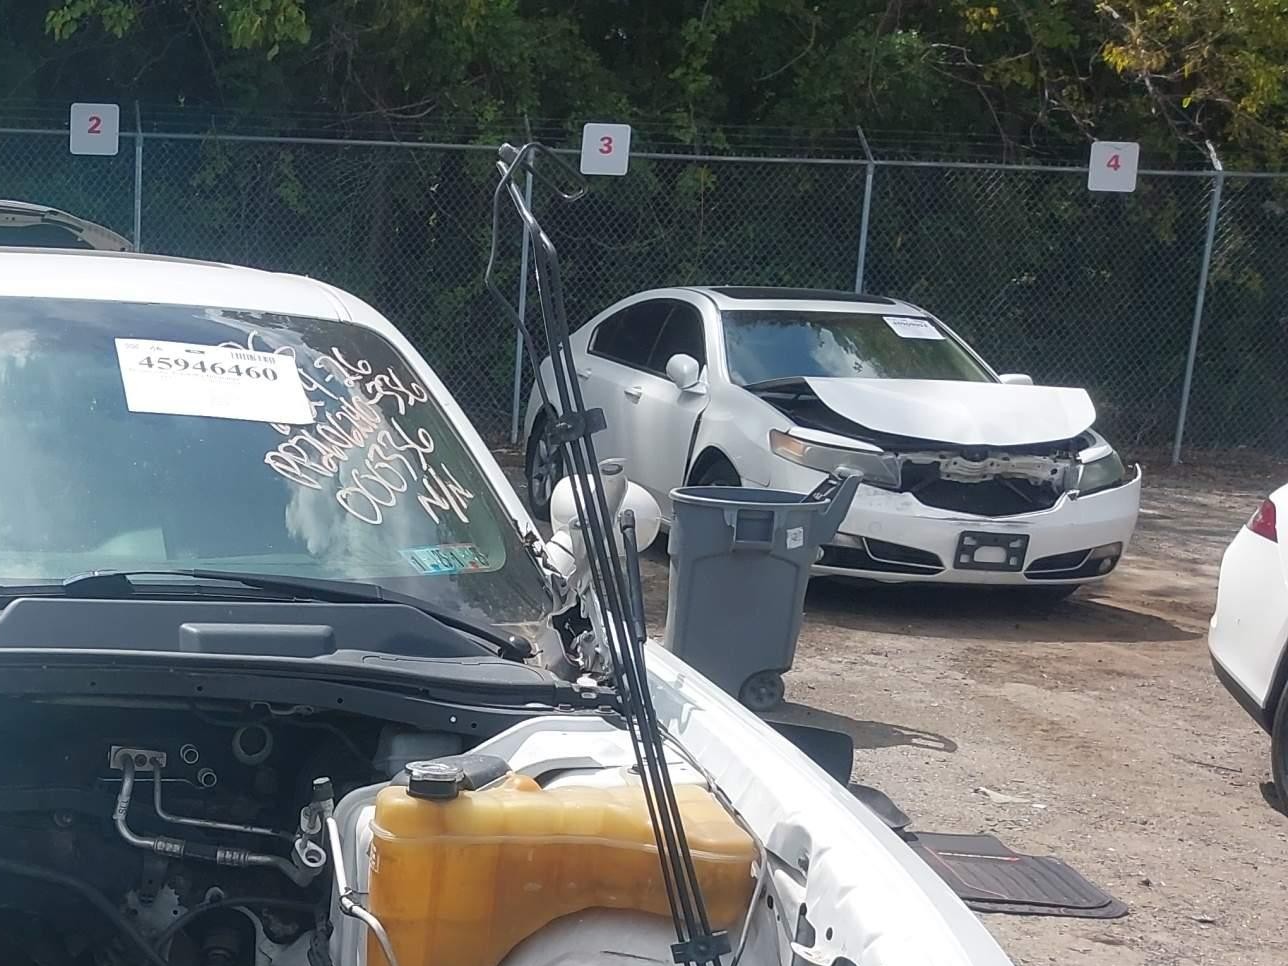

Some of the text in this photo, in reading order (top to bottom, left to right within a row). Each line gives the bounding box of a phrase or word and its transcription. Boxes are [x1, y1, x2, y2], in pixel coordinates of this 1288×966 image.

[87, 116, 102, 134] 2
[599, 136, 613, 154] 3
[1106, 154, 1121, 171] 4
[138, 356, 278, 381] 45946460
